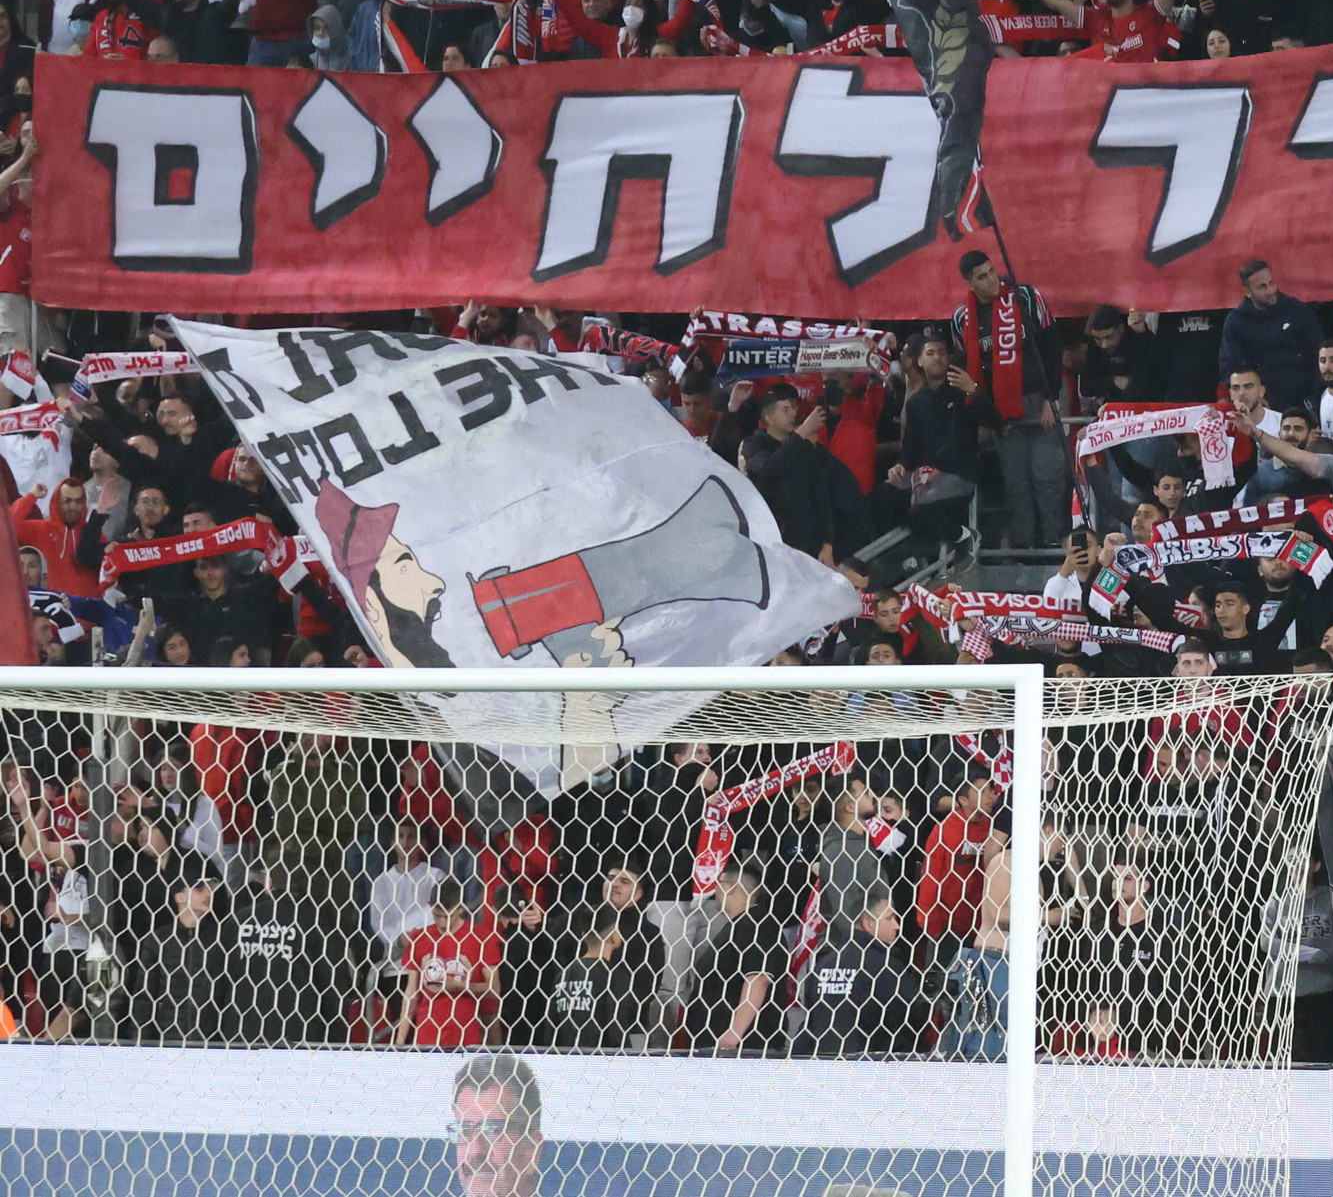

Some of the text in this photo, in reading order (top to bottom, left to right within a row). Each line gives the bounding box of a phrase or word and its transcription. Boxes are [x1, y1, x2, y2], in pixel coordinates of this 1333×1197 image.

[1002, 13, 1033, 29] SHEVA
[85, 62, 943, 288] לחיים
[998, 292, 1017, 366] הפועל
[729, 348, 794, 368] INTER
[1155, 498, 1307, 542] HAPOEL
[125, 520, 257, 565] HAPOEL BEER SHEVA
